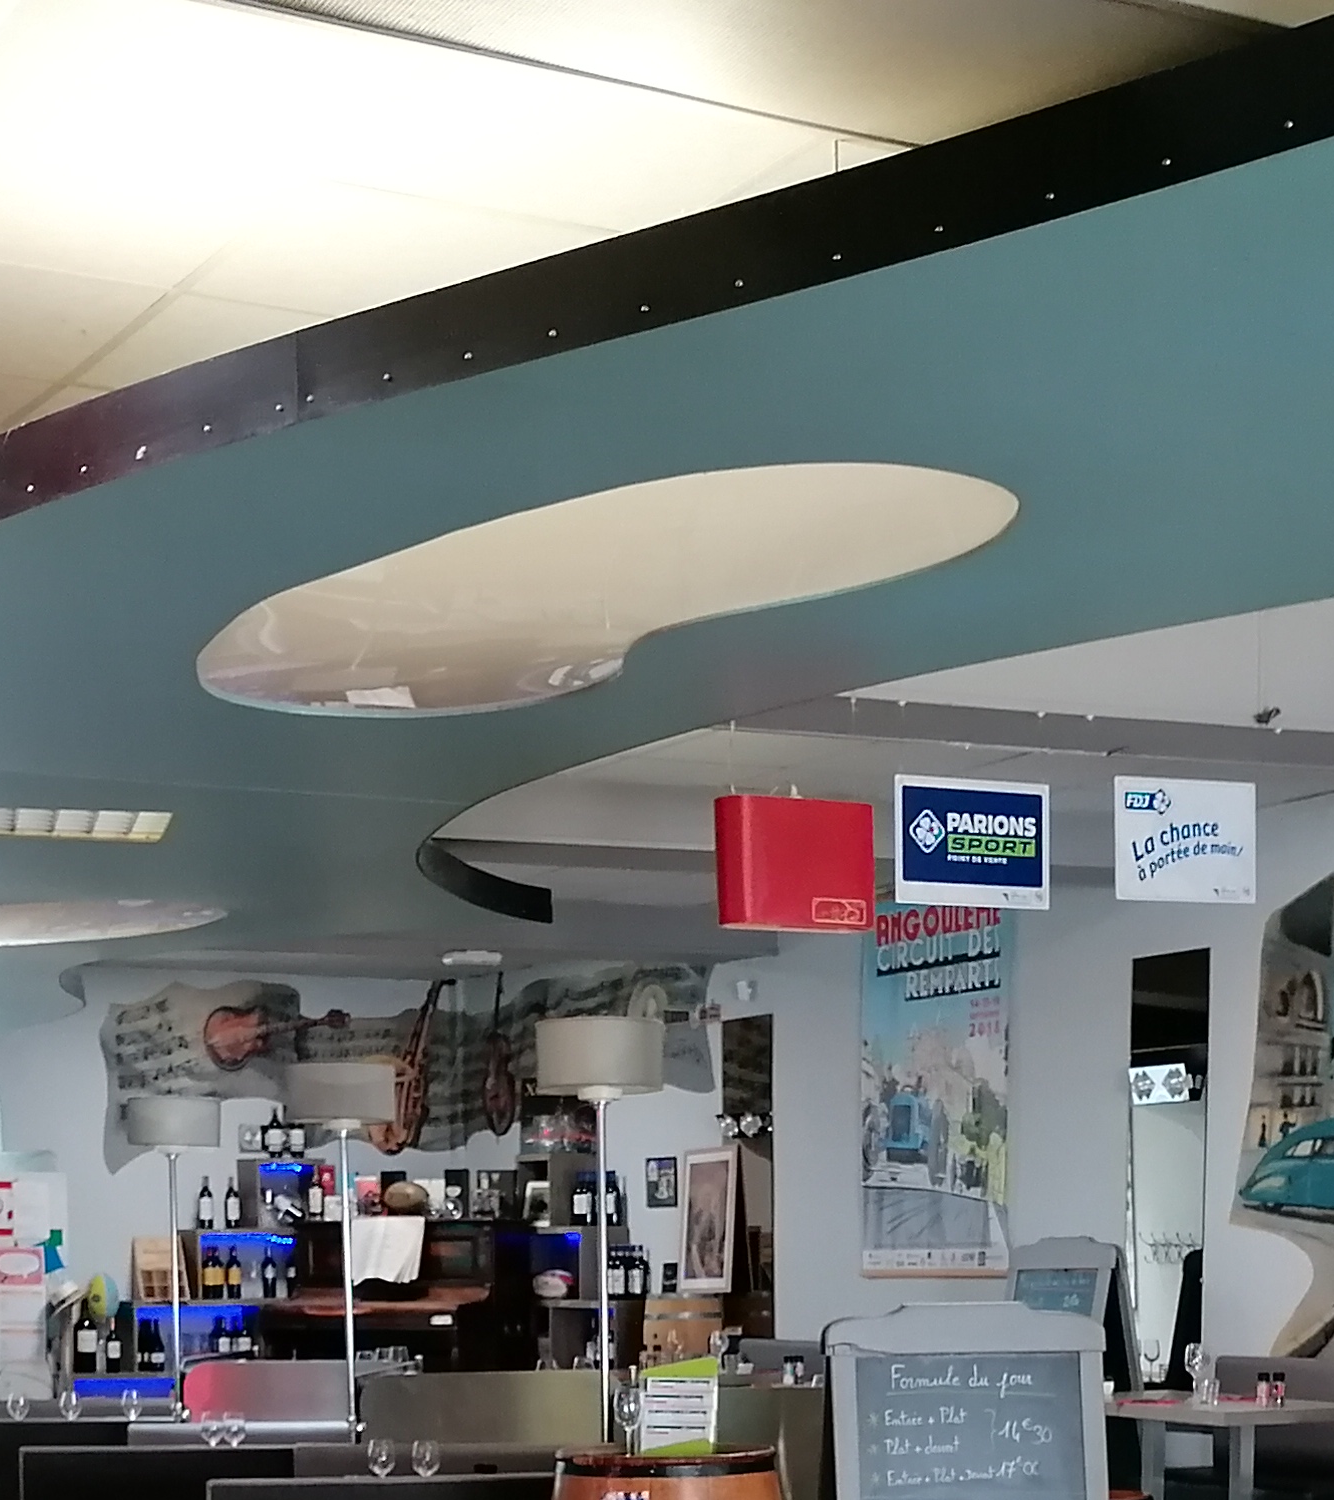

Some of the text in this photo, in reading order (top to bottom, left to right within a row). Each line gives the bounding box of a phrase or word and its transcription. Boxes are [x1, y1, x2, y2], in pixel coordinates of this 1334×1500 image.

[1127, 793, 1151, 808] FDJ
[946, 812, 1037, 838] PARIONS
[1132, 822, 1219, 862] La chance
[950, 837, 1032, 854] SPORT
[1138, 865, 1147, 881] à
[1149, 844, 1190, 879] portée
[1193, 841, 1208, 856] de
[877, 934, 955, 972] CIRCUIT
[891, 1364, 1034, 1398] Formule du jour
